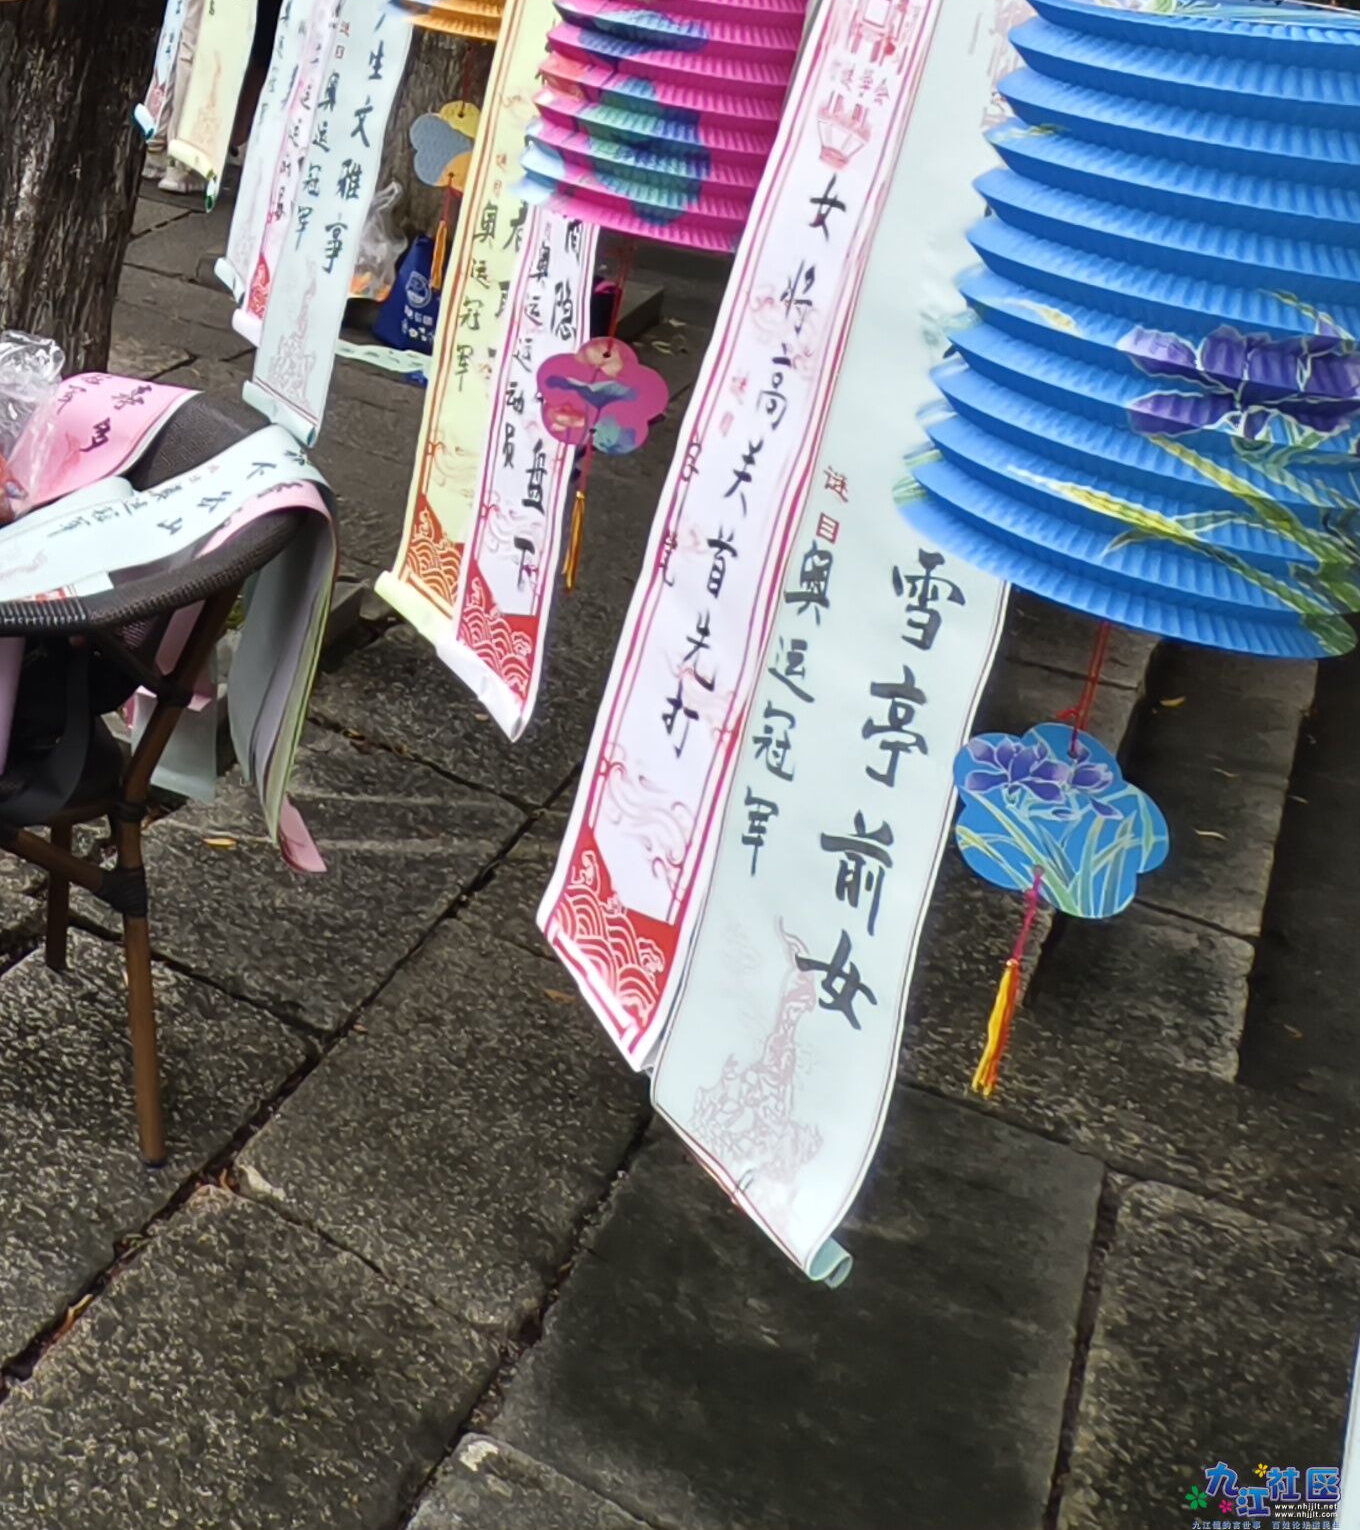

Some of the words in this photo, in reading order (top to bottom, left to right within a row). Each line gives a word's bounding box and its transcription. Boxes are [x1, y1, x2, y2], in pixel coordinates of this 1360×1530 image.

[321, 12, 387, 275] 生文雅事
[739, 539, 835, 878] 奥运冠军
